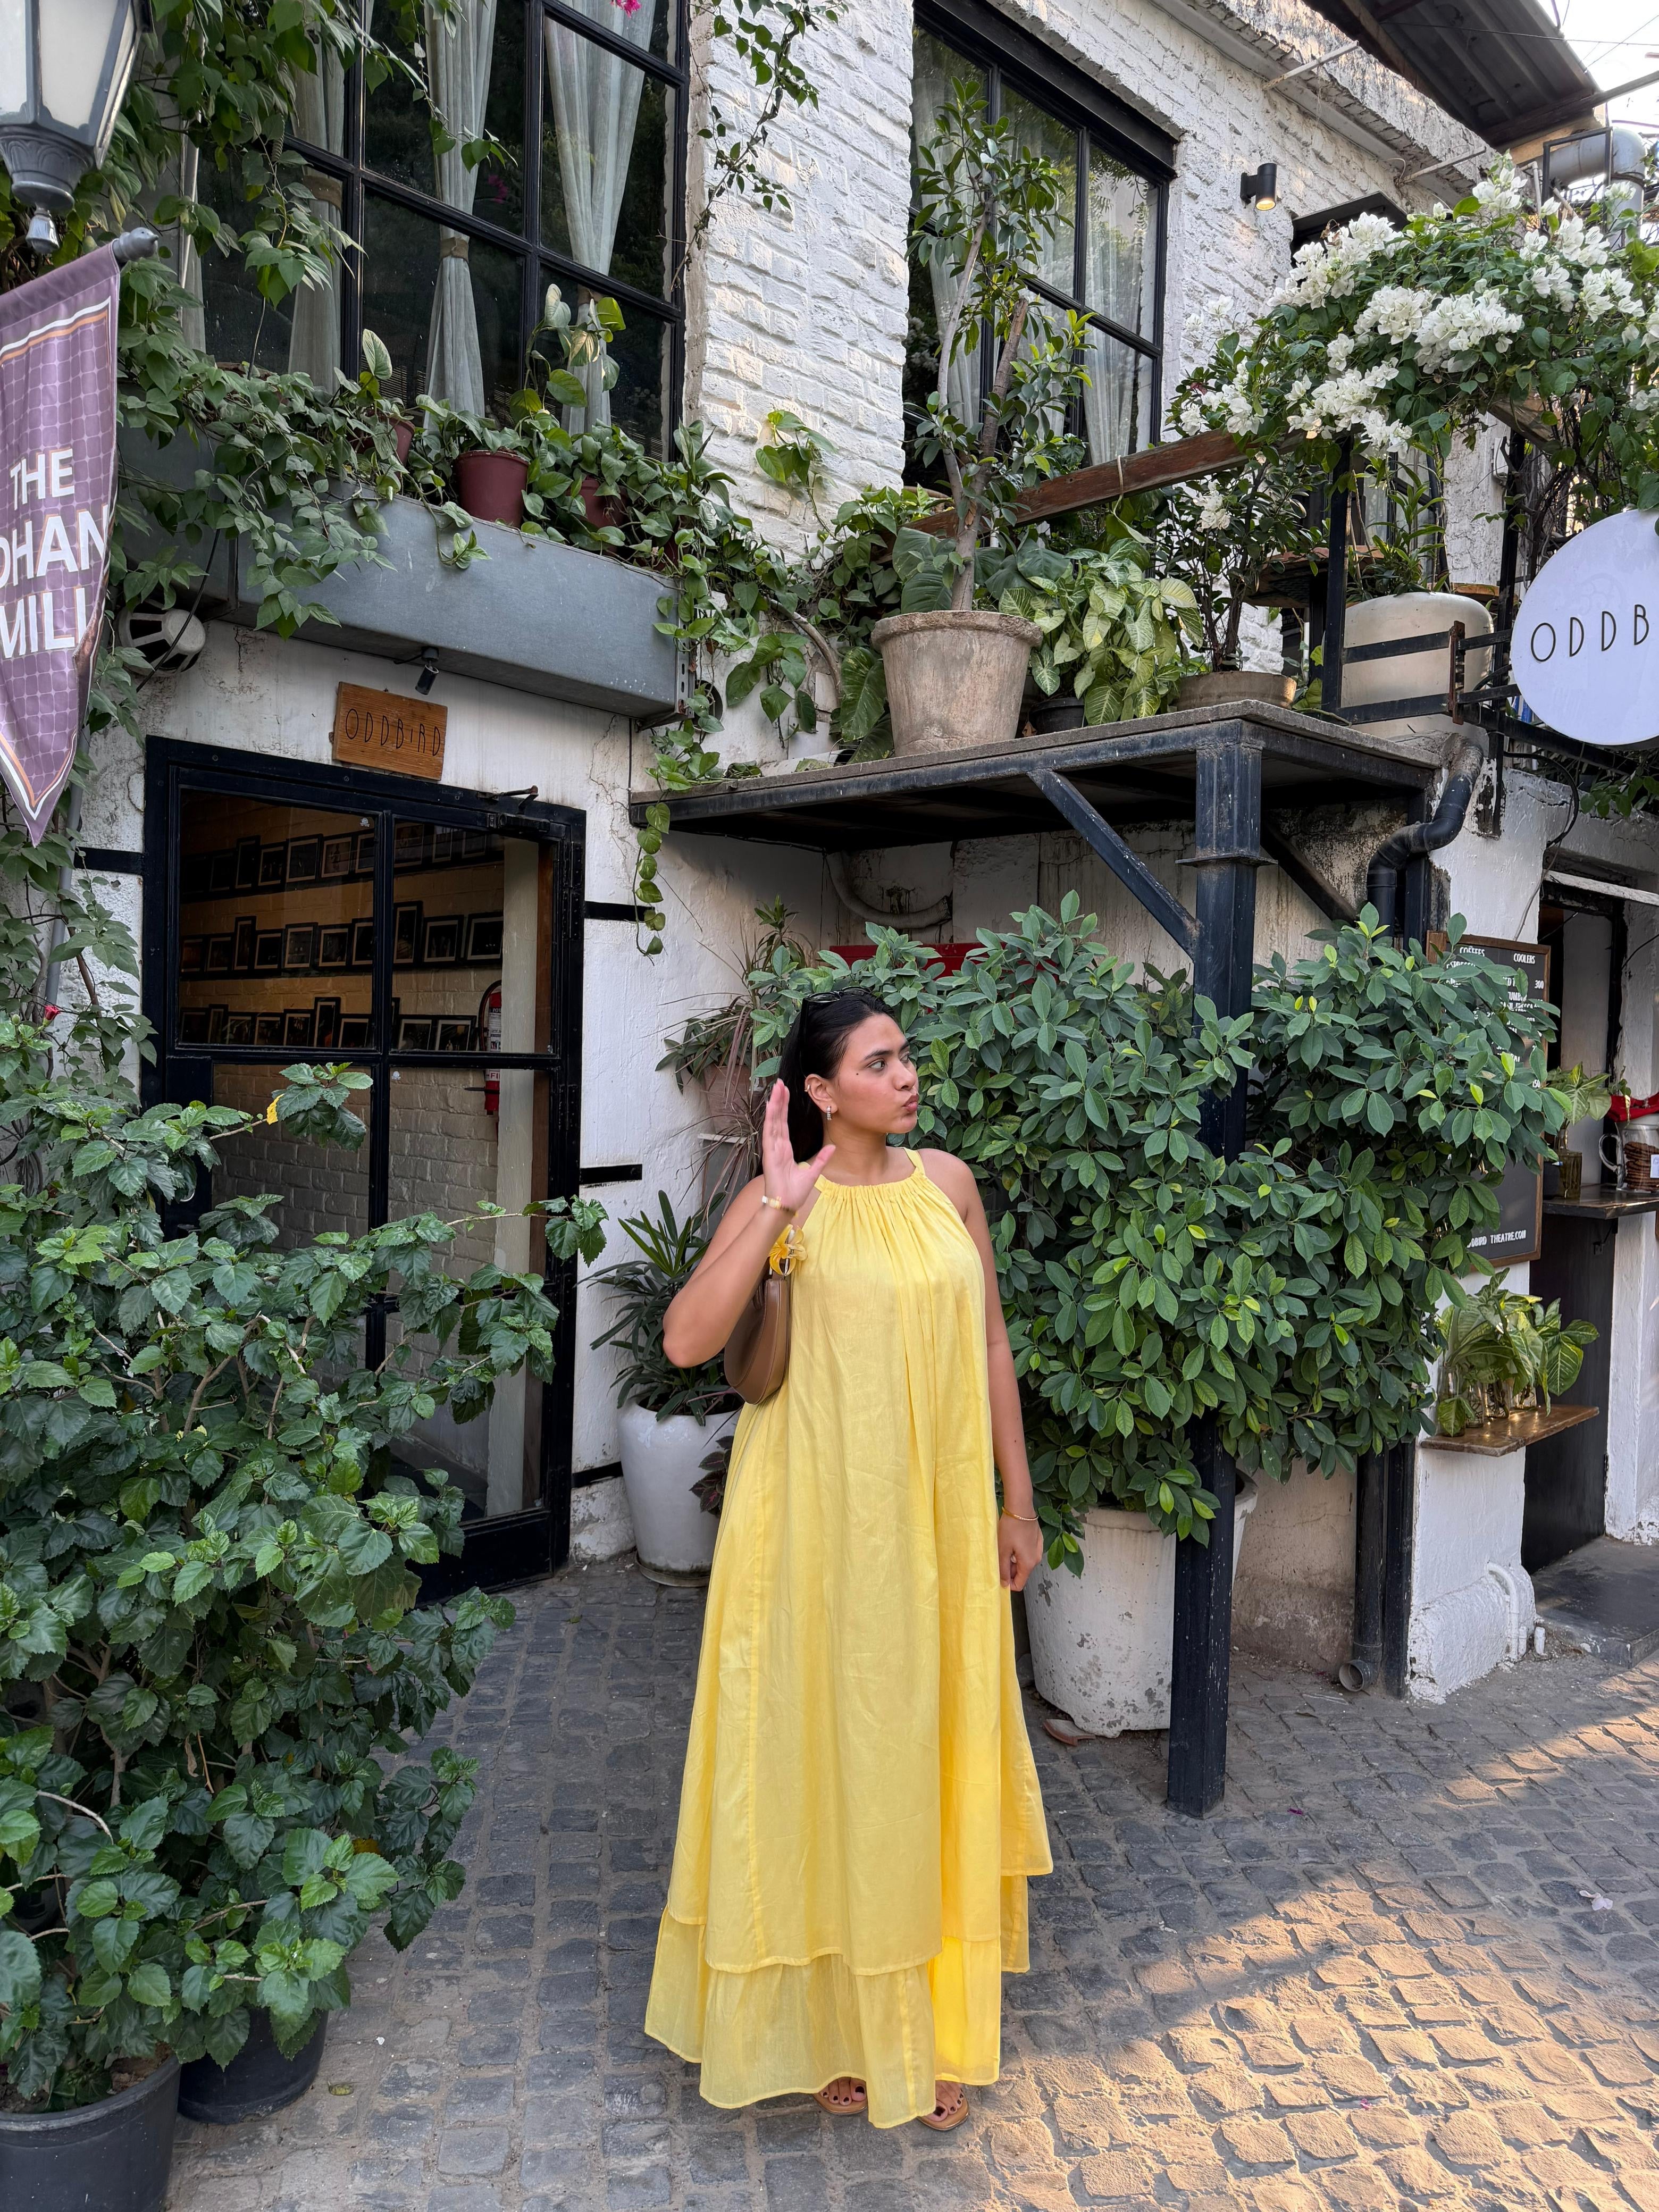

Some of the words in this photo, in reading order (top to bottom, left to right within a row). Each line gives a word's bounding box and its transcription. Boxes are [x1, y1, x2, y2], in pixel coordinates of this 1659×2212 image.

[10, 448, 75, 510] THE
[345, 708, 441, 756] ODDBIRD
[1513, 953, 1535, 964] COOLERS
[1535, 980, 1544, 989] 300
[1490, 1230, 1526, 1244] THEATRE.COM
